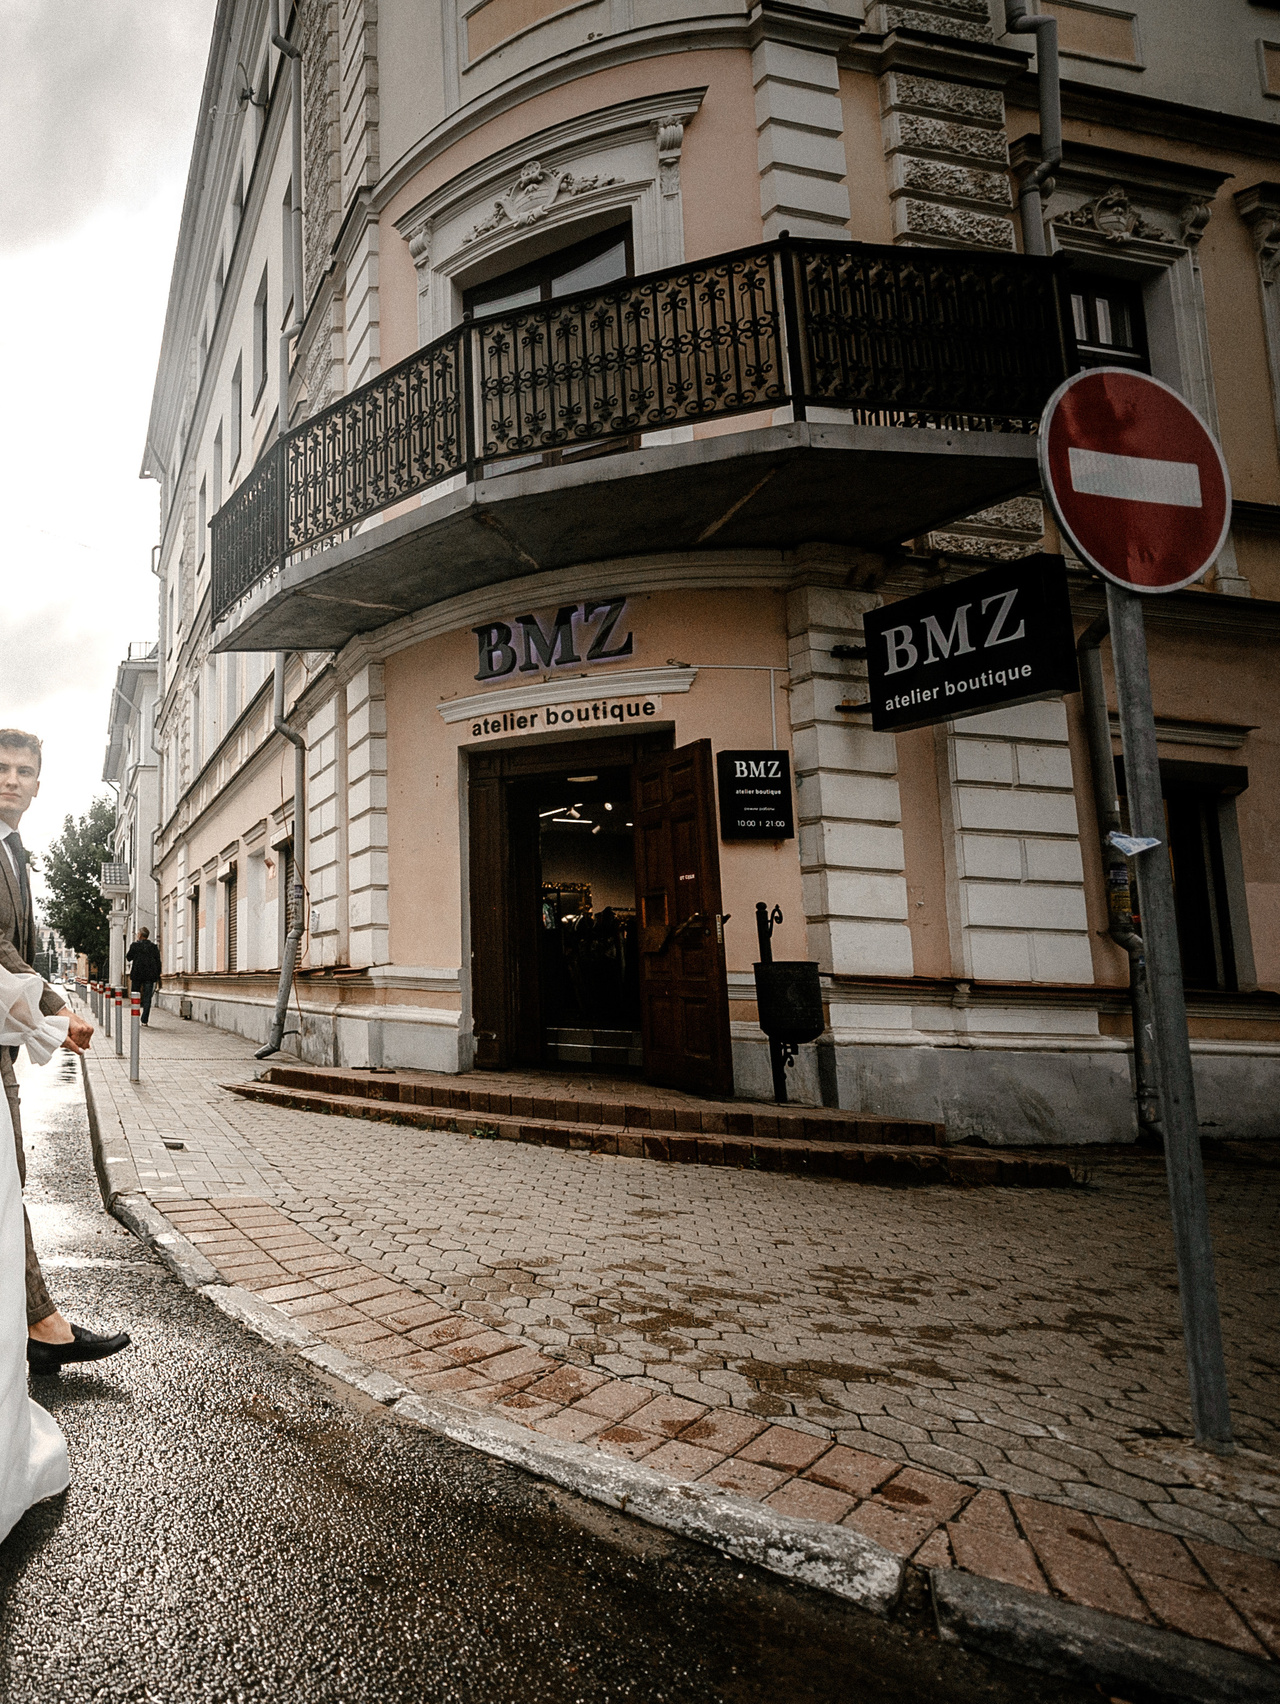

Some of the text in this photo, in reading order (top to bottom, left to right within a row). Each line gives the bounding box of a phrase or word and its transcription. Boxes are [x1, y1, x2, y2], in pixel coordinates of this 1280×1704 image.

[471, 596, 634, 682] BMZ
[881, 588, 1026, 676] BMZ
[885, 662, 1033, 712] atelier boutique
[471, 700, 656, 737] atelier boutique
[734, 760, 782, 778] BMZ
[755, 788, 782, 796] boutique
